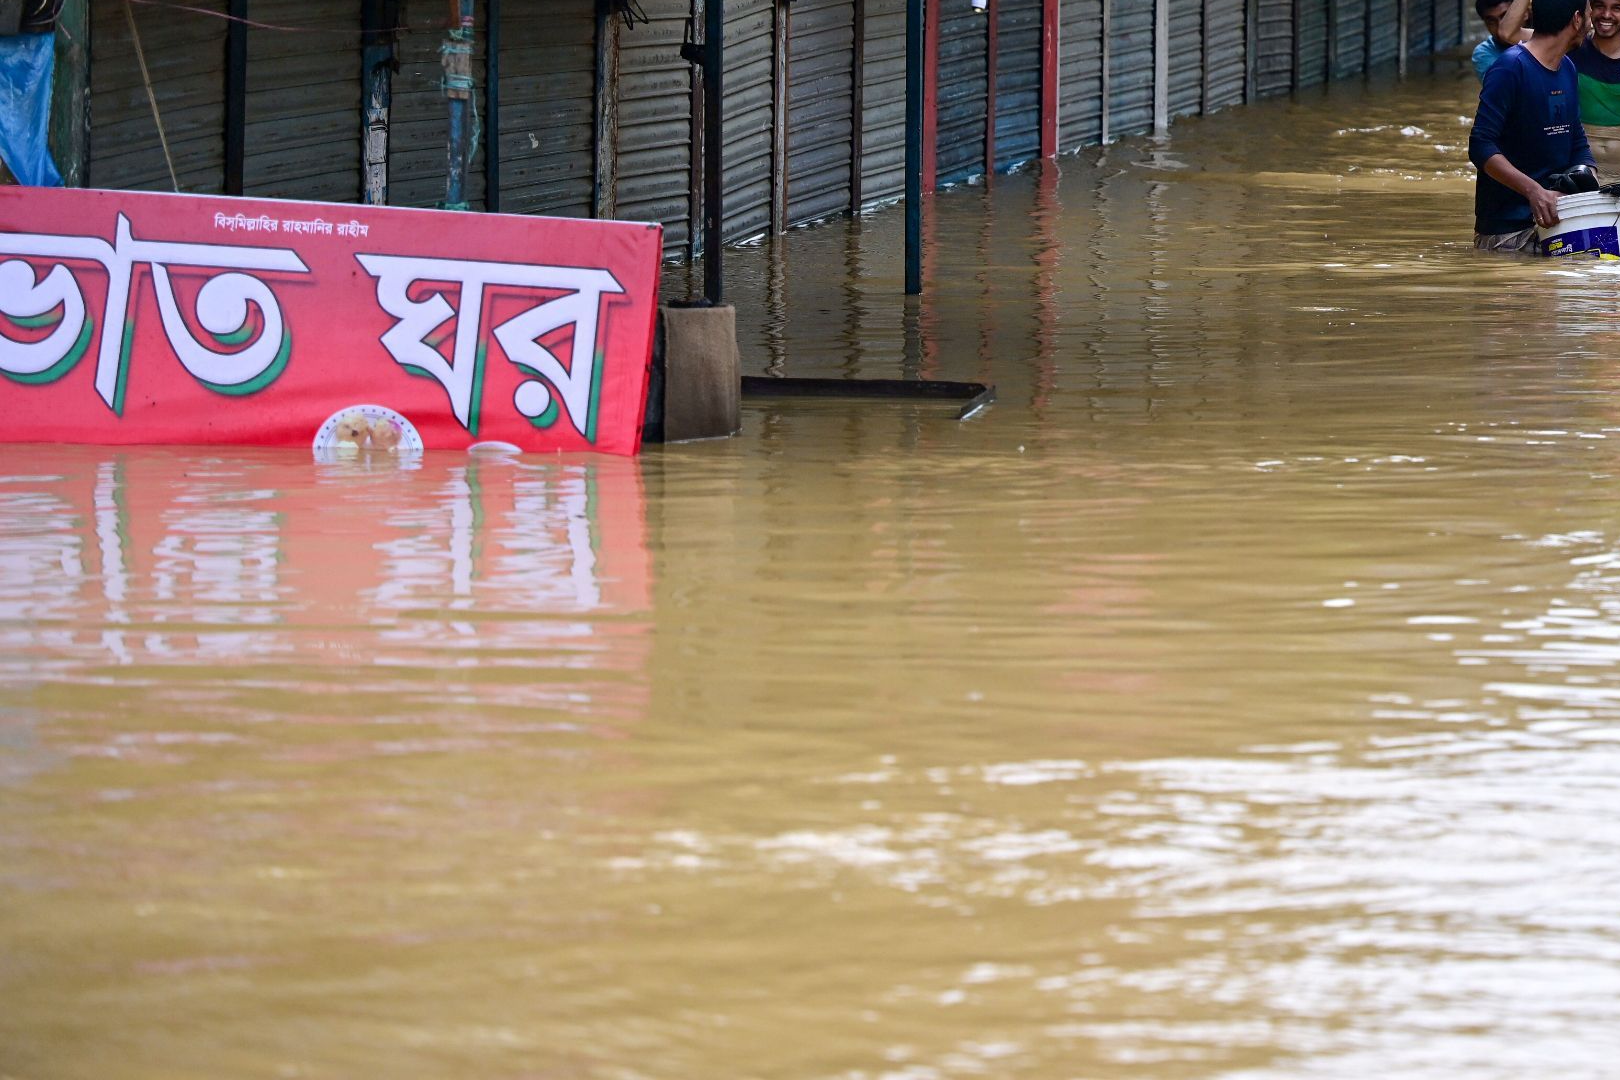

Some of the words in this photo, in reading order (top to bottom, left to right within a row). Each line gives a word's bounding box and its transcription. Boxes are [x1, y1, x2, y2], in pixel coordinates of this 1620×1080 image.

[282, 217, 333, 237] রাহমানির
[336, 219, 369, 238] রাহীম
[0, 212, 311, 413] ভাত
[353, 252, 625, 443] ঘর
